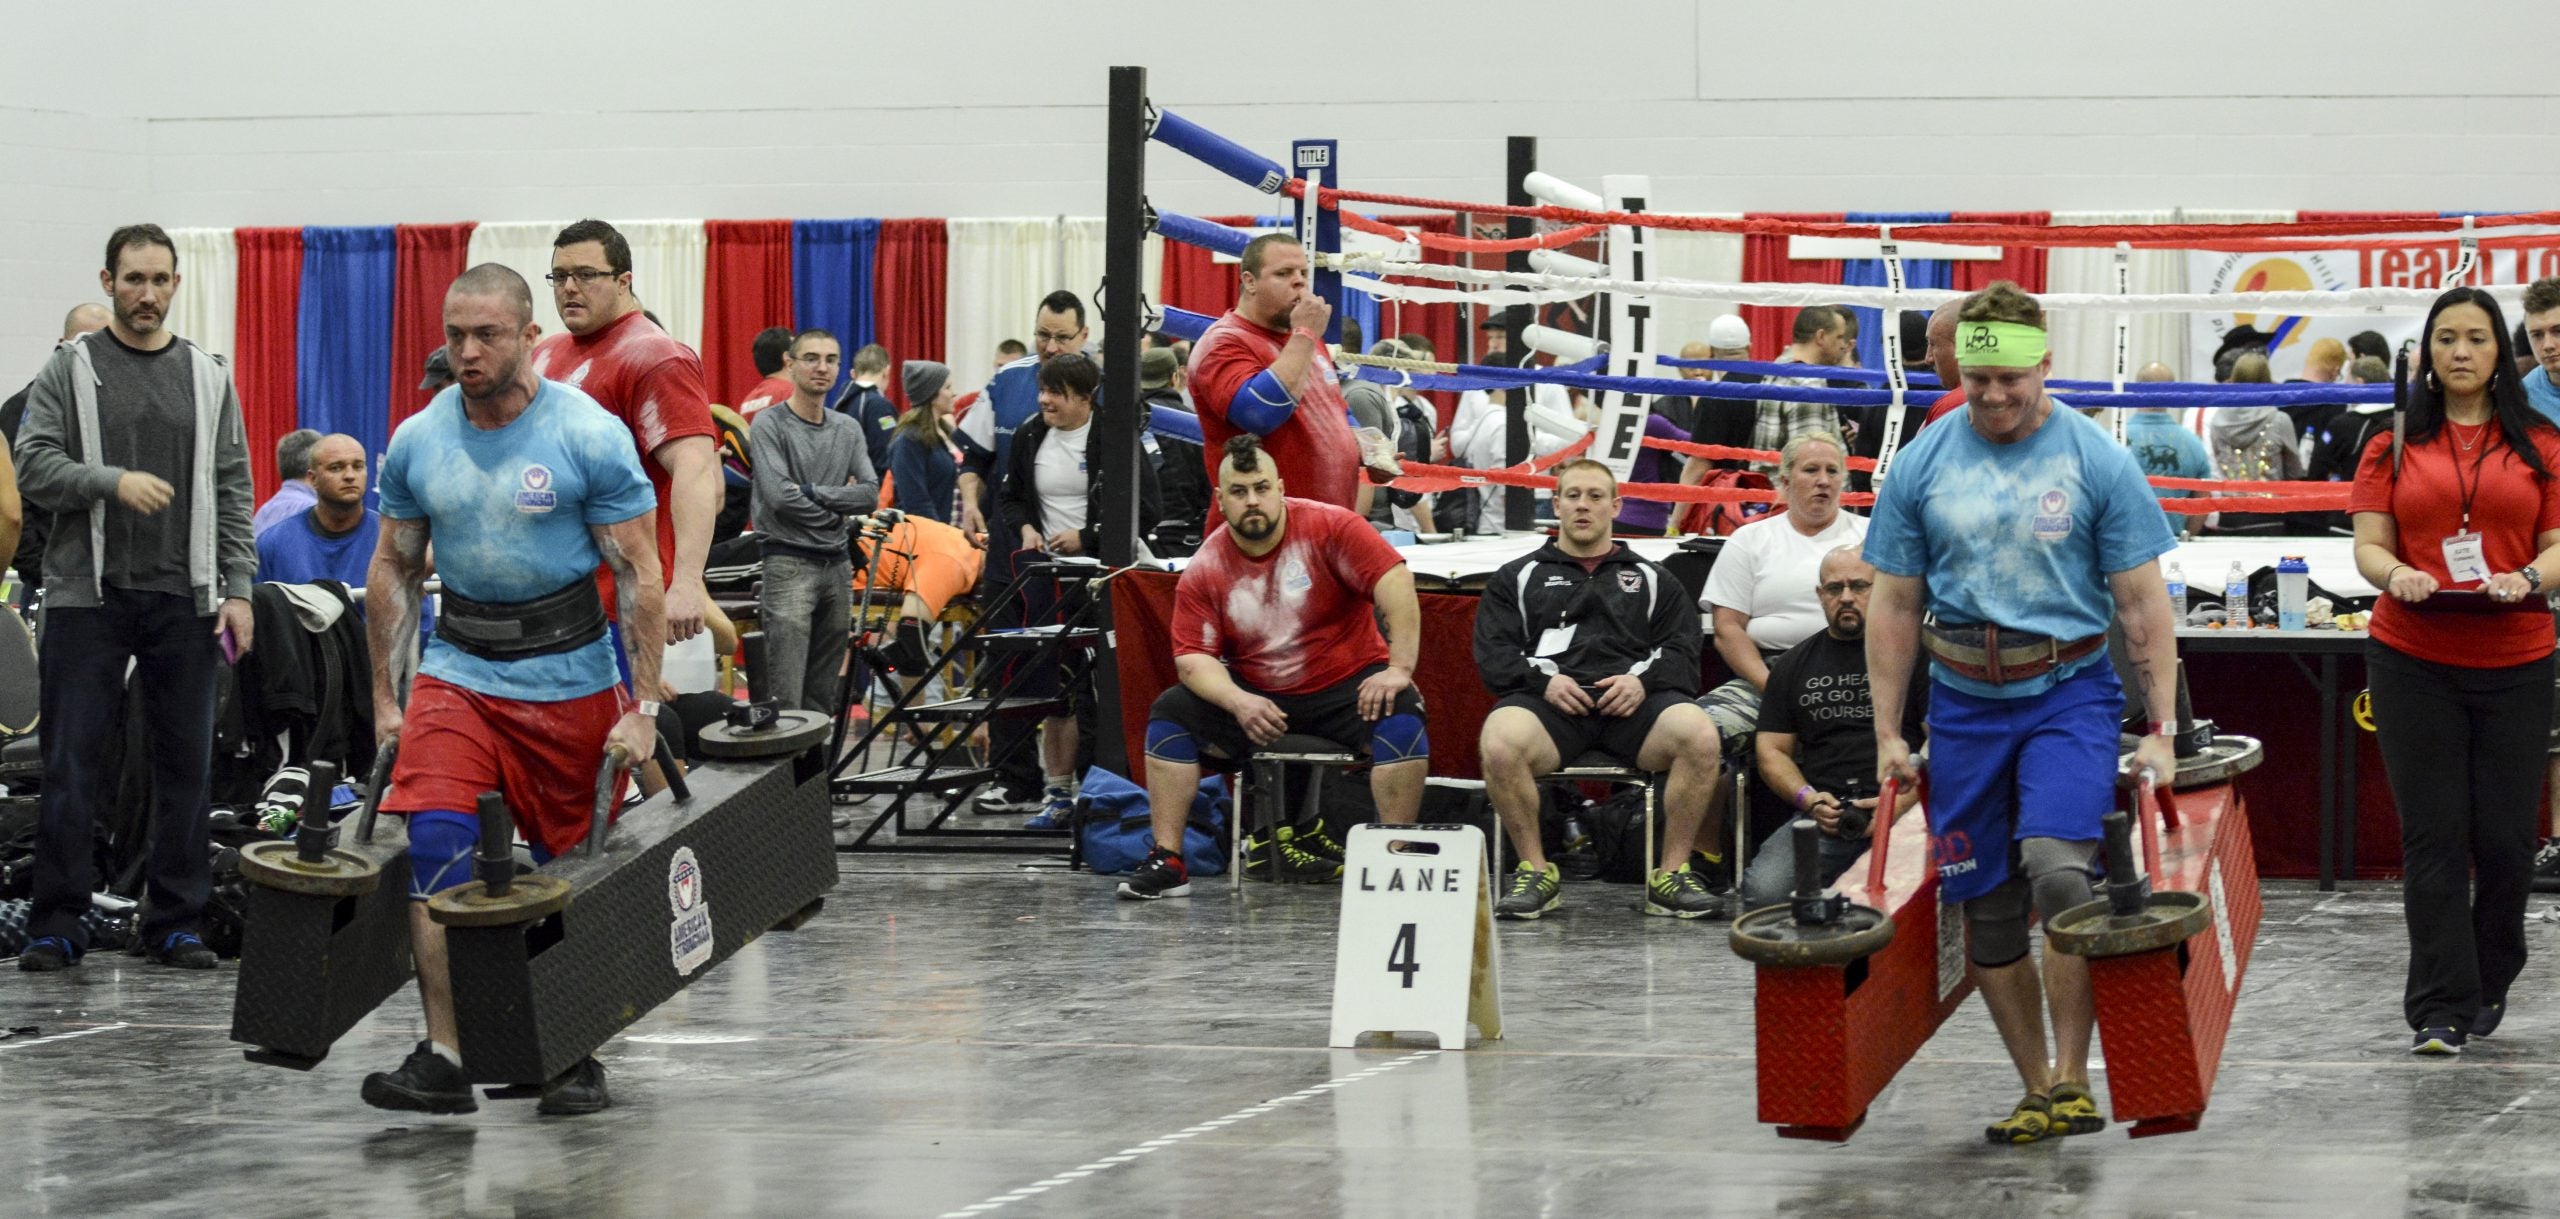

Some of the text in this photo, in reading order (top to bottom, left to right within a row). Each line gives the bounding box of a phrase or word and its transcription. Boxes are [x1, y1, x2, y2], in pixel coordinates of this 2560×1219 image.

[1301, 149, 1325, 162] TITLE
[1608, 197, 1651, 460] TITLE
[1879, 421, 1898, 474] TITLE
[1805, 672, 1869, 689] GO HEA
[1799, 691, 1823, 706] OR
[1828, 689, 1855, 702] GO
[1809, 704, 1874, 720] YOURSE
[1361, 867, 1460, 892] LANE
[1387, 922, 1420, 989] 4
